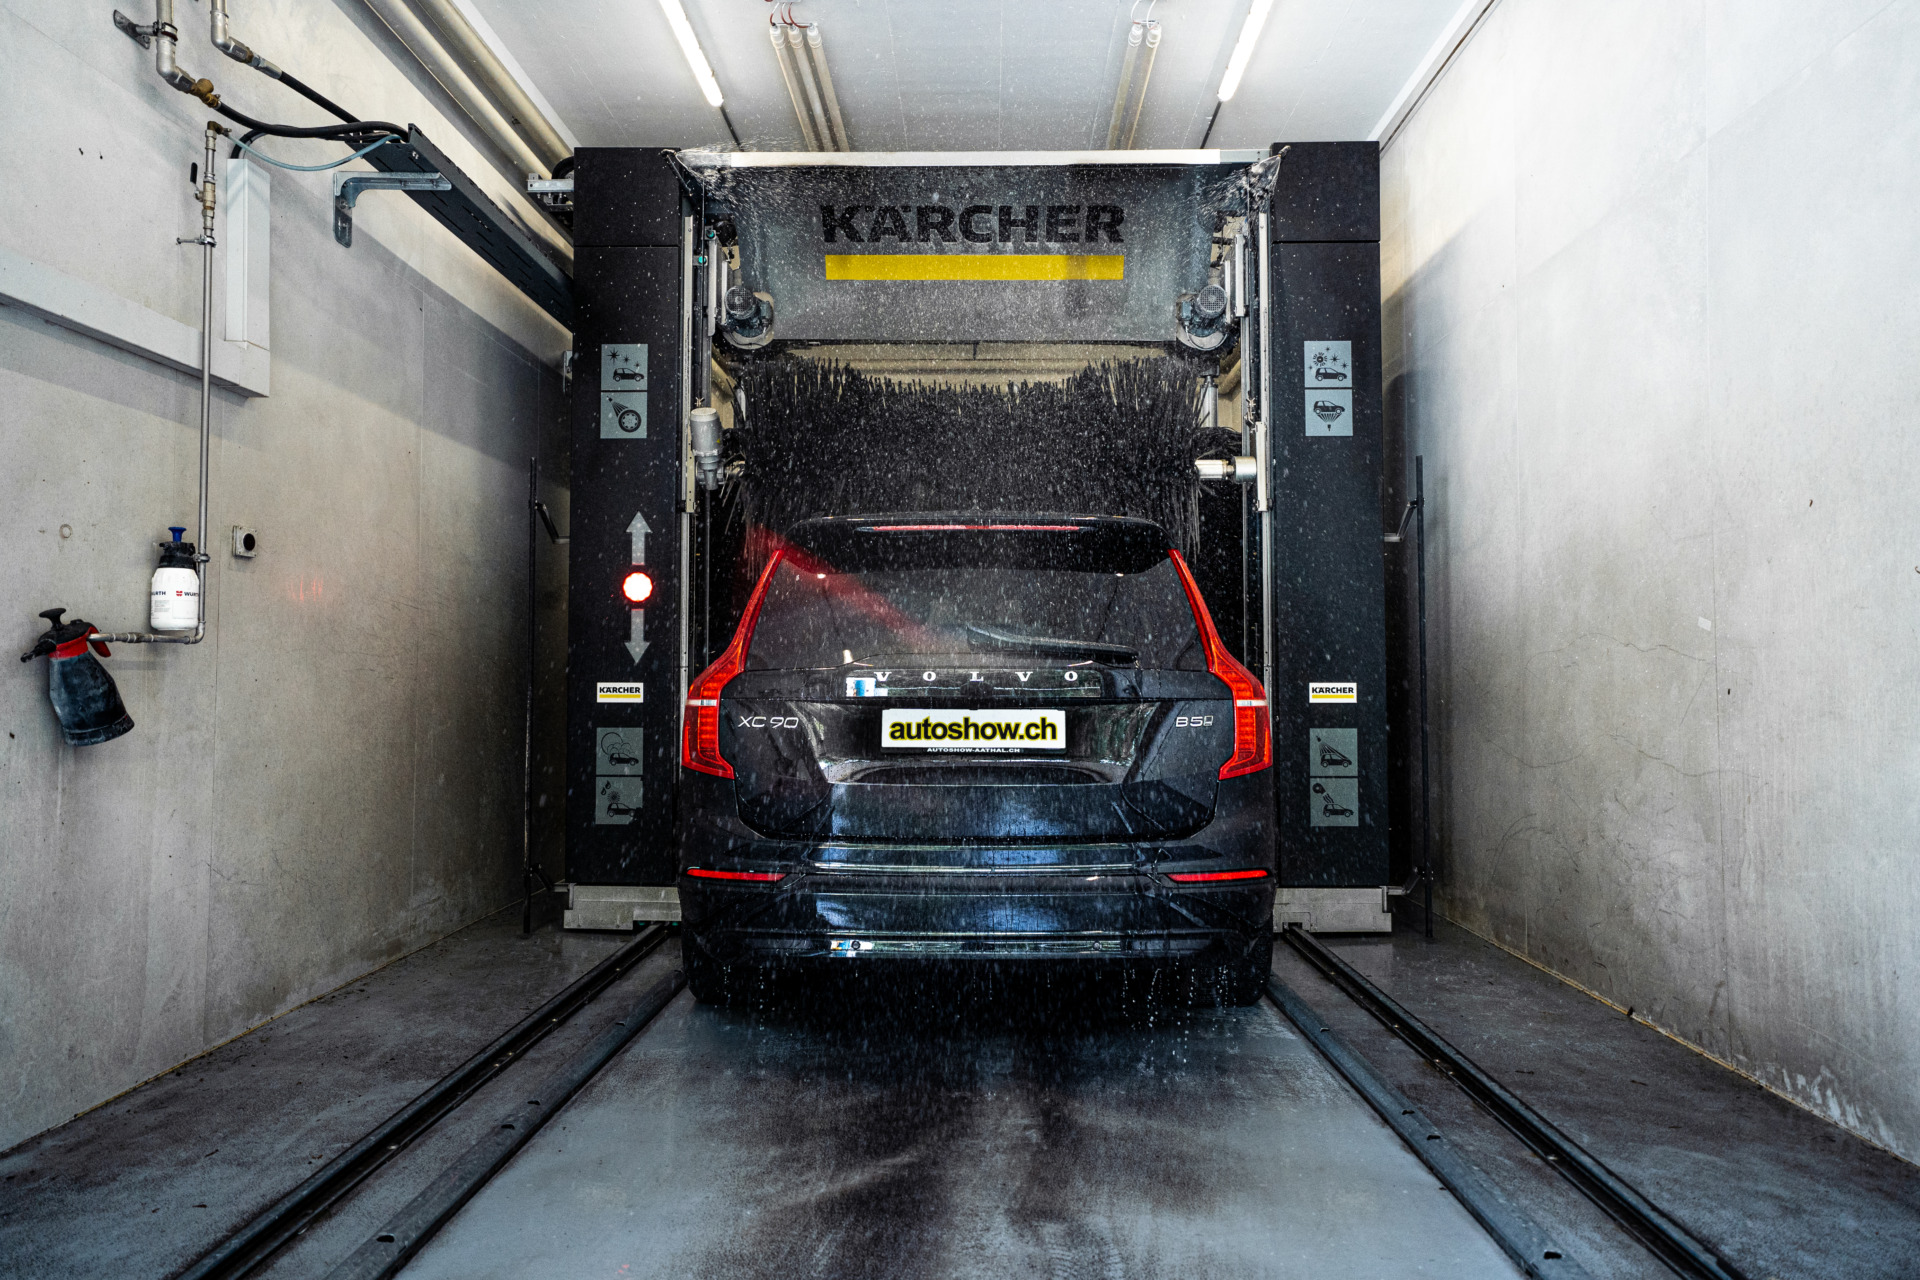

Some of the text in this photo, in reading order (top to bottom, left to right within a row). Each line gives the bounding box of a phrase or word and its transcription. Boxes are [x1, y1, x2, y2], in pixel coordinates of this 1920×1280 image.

[821, 204, 1125, 243] KÄRCHER
[874, 671, 1078, 682] VOLVO
[737, 715, 799, 729] XC90
[889, 716, 1058, 741] autoshow.ch
